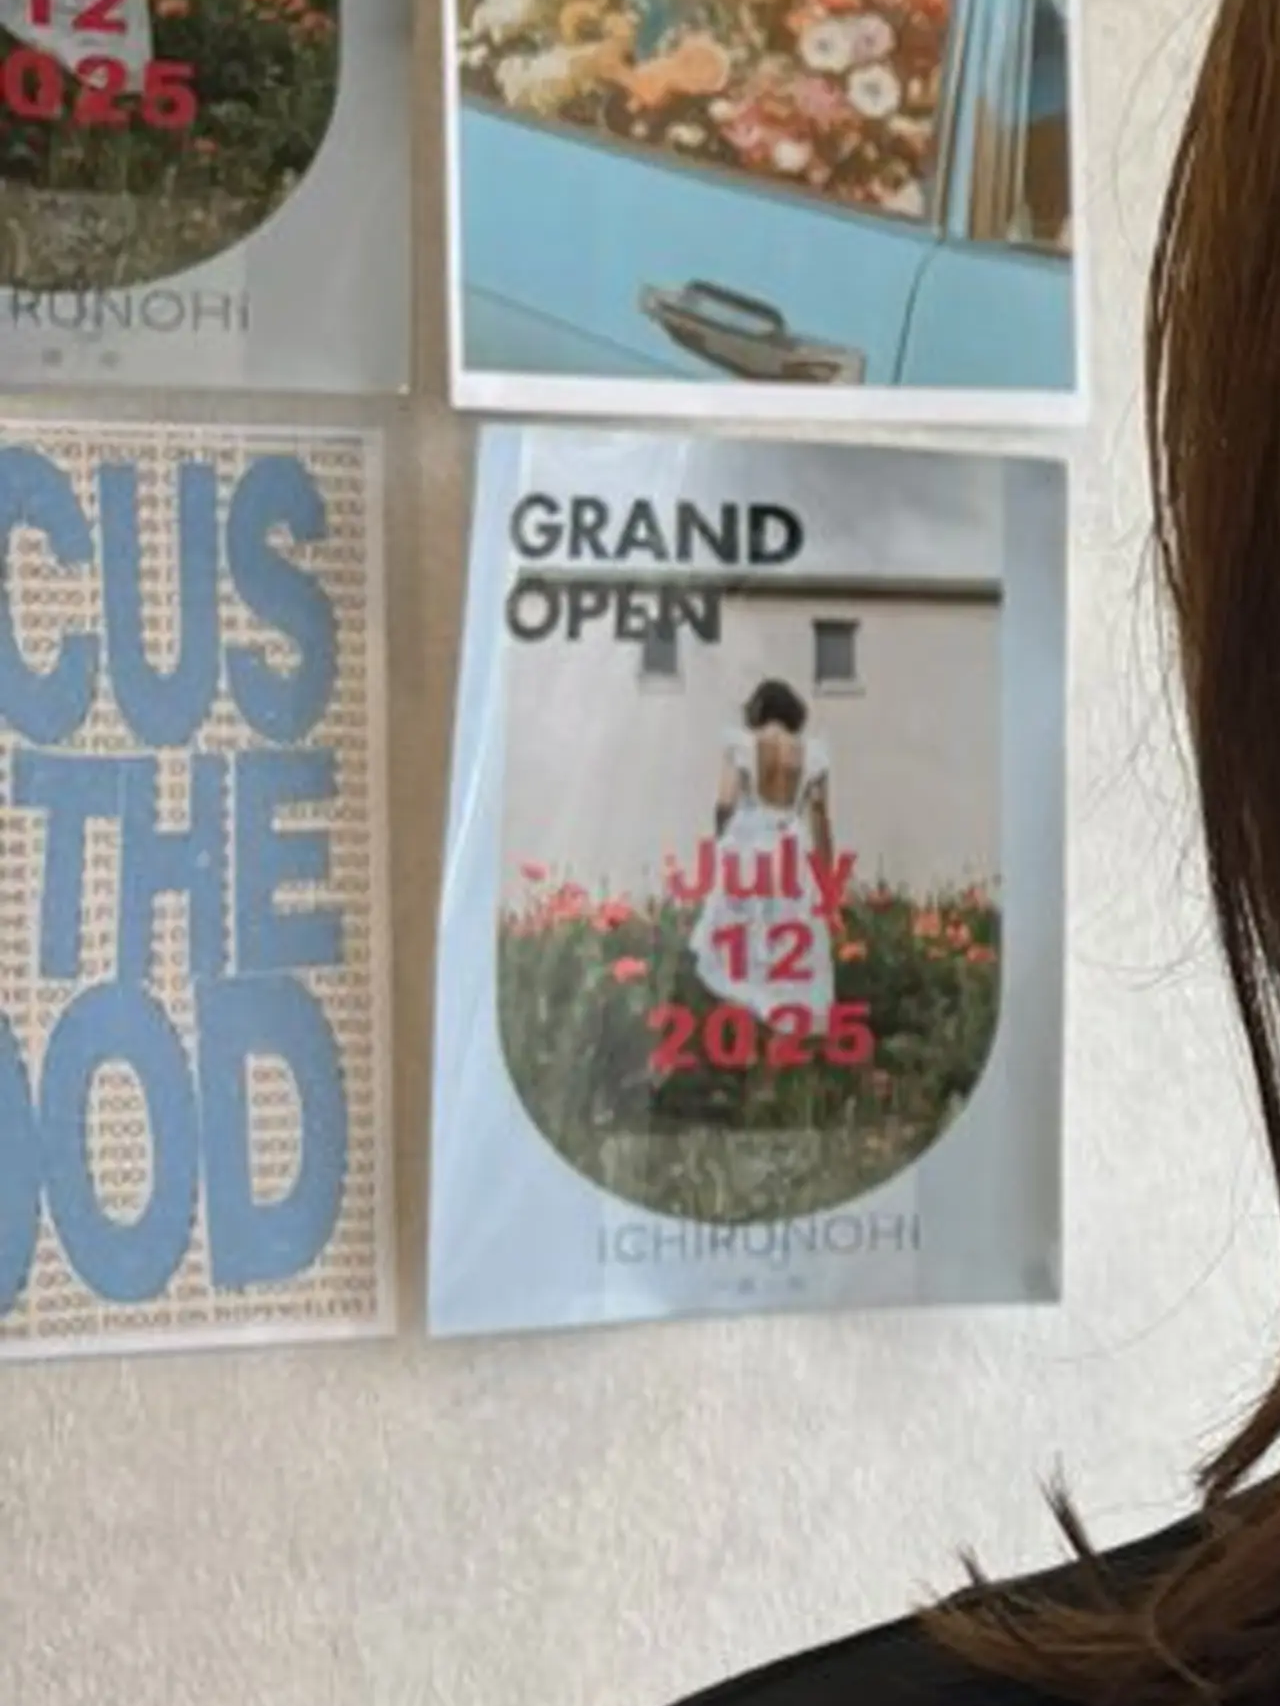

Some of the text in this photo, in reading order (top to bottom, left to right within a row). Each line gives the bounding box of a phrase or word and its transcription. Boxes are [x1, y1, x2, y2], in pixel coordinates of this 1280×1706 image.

[510, 494, 804, 563] GRAND
[0, 445, 339, 748] CUS
[505, 577, 722, 643] OPEN
[13, 744, 345, 981] THE
[666, 834, 857, 917] July
[711, 921, 815, 983] 12
[648, 1000, 876, 1070] 2025
[0, 975, 348, 1317] OD
[598, 1213, 921, 1265] ICHIRUNOHI
